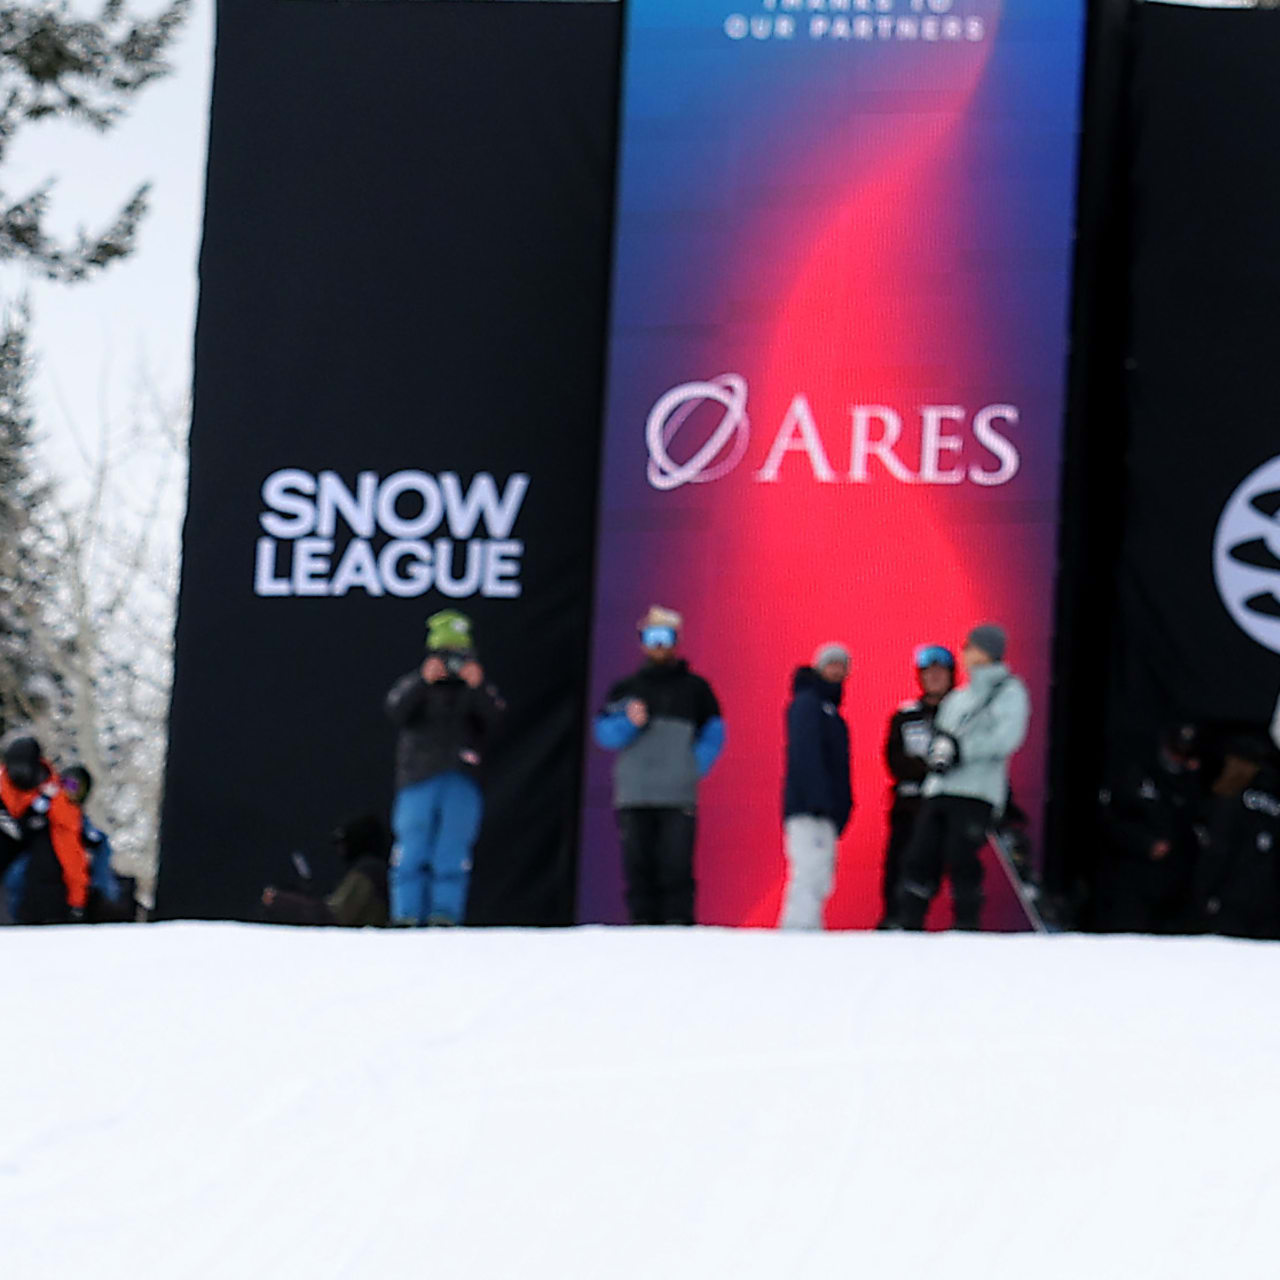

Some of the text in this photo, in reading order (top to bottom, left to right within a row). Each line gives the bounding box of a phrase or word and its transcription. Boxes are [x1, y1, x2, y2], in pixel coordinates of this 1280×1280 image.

[724, 13, 984, 41] OUR PARTNERS
[756, 394, 1021, 486] ARES
[259, 468, 529, 539] SNOW
[255, 537, 525, 598] LEAGUE
